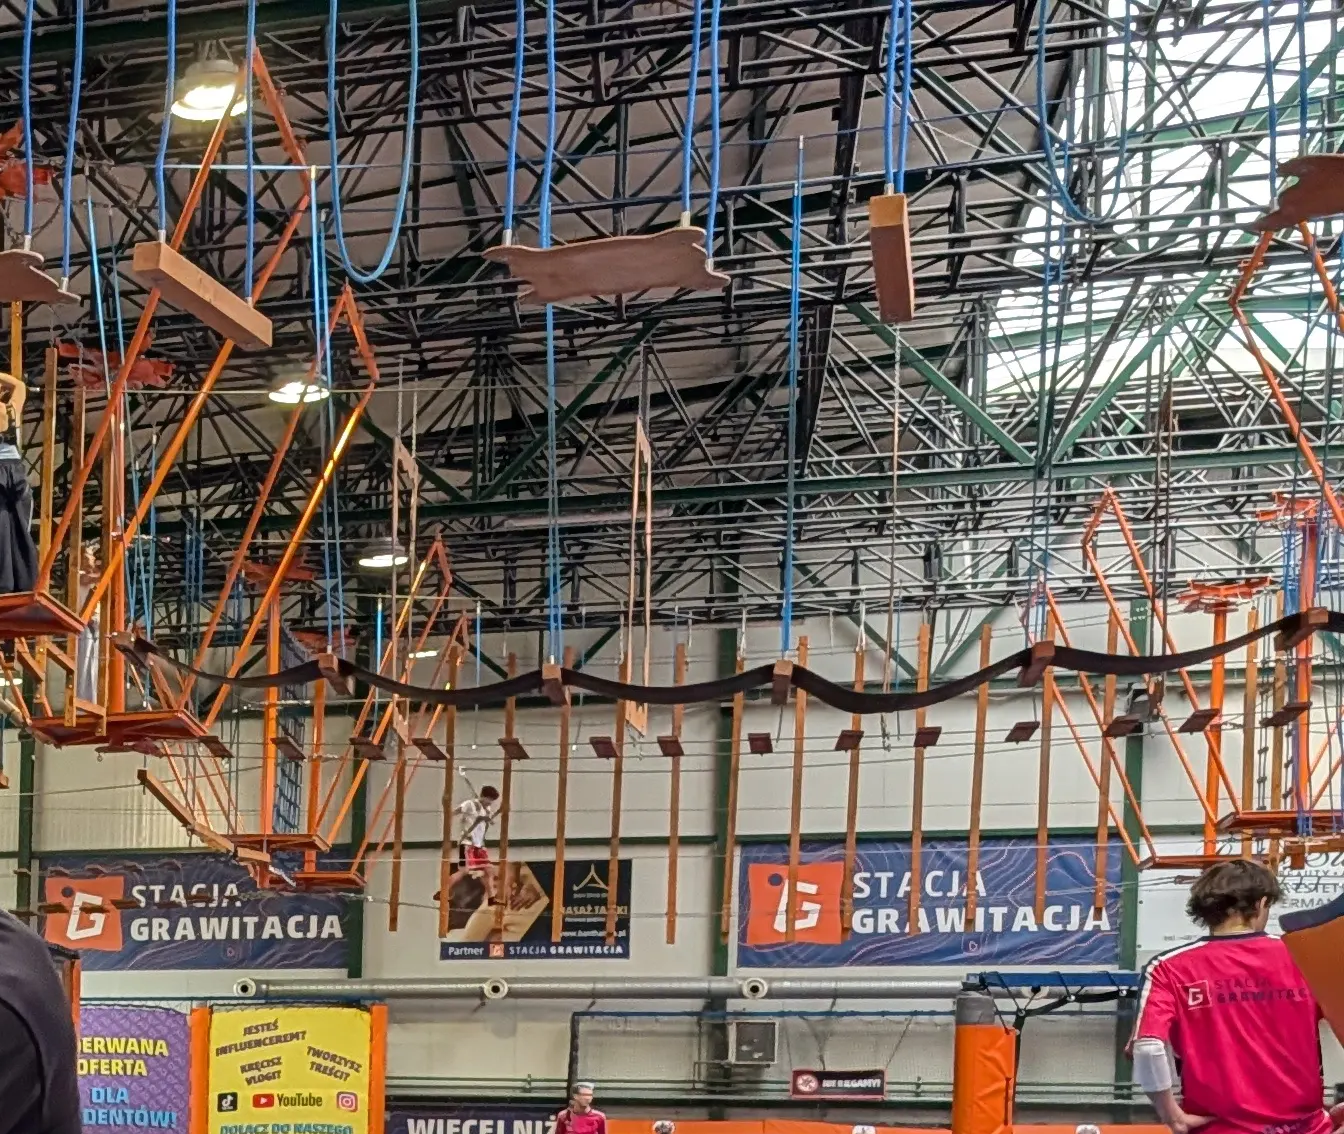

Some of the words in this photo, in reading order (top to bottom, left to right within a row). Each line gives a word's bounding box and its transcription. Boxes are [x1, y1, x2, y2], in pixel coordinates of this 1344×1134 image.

[131, 883, 242, 908] STACJA
[130, 915, 344, 941] GRAWITACJA
[851, 905, 1111, 934] GRAWITACJA
[448, 946, 484, 956] Partner
[509, 946, 547, 954] STACJA
[550, 945, 624, 954] GRAWITACJA
[80, 1037, 169, 1057] ERWANA
[215, 1030, 307, 1057] INFLUENCEREM?
[77, 1058, 148, 1076] OFERTA
[307, 1045, 362, 1073] TWORZYSZ
[91, 1087, 129, 1104] DLA
[277, 1093, 323, 1107] YouTube
[82, 1105, 178, 1129] DENTÓW!
[271, 1123, 291, 1134] DO
